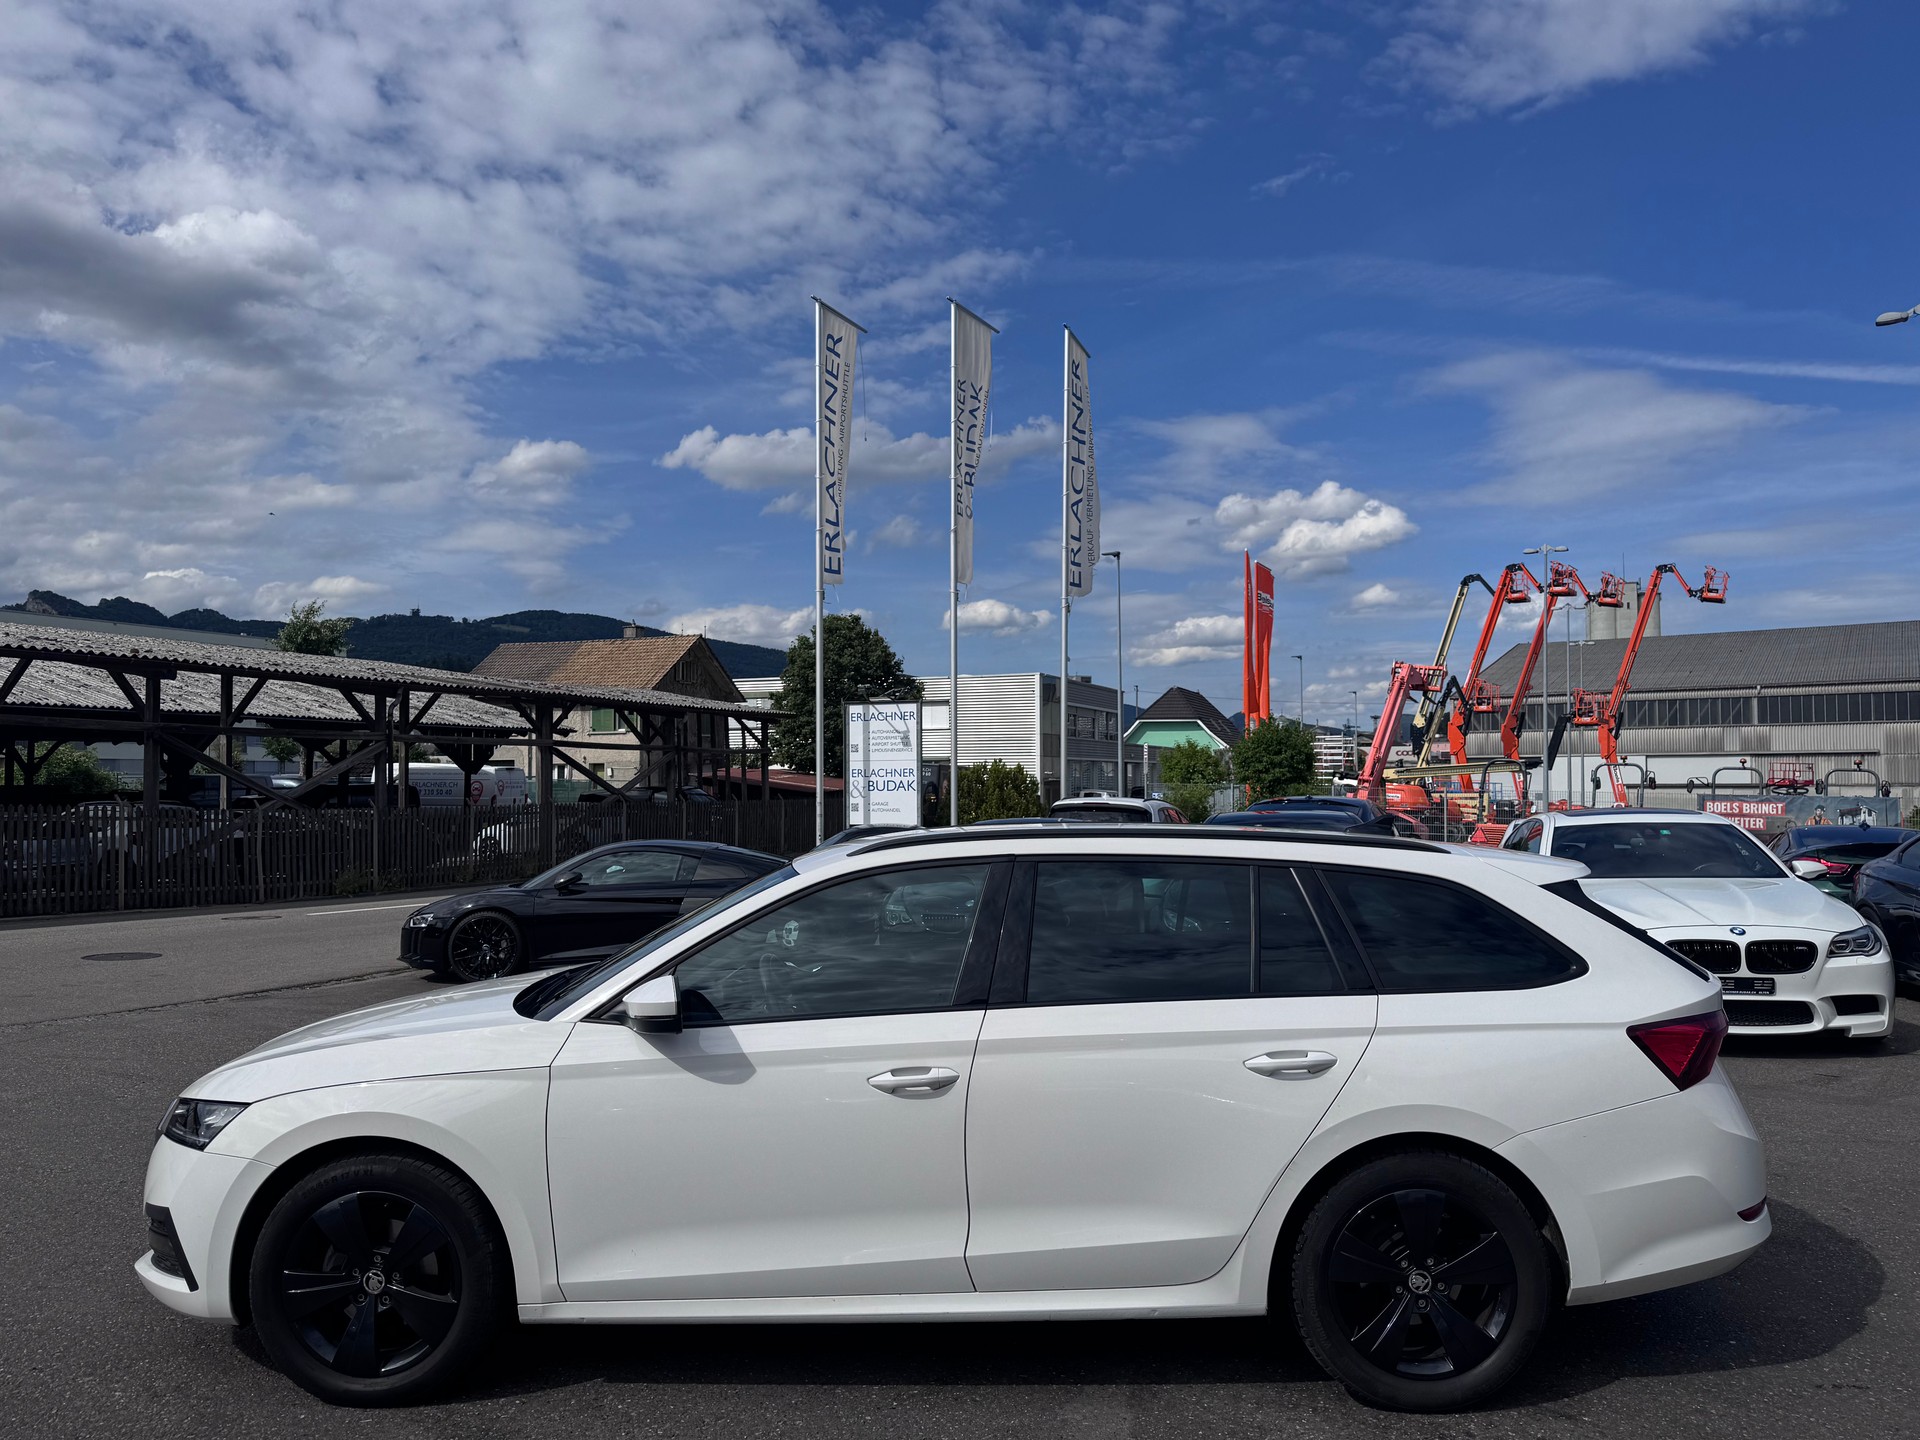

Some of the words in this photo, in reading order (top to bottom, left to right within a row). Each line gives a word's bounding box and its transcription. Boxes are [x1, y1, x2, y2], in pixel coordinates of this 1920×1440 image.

[839, 362, 851, 443] AIRPORTSHUTTLE
[824, 333, 843, 575] ERLACHNER
[956, 379, 966, 518] ERLACHNER
[1069, 359, 1086, 588] ERLACHNER
[1086, 466, 1094, 523] VERMIETUNG
[1087, 530, 1096, 567] VERKAUF
[850, 711, 916, 722] ERLACHNER
[851, 768, 915, 778] ERLACHNER
[867, 780, 916, 792] BUDAK
[1706, 802, 1740, 813] BOELS
[1743, 803, 1784, 814] BRINGT
